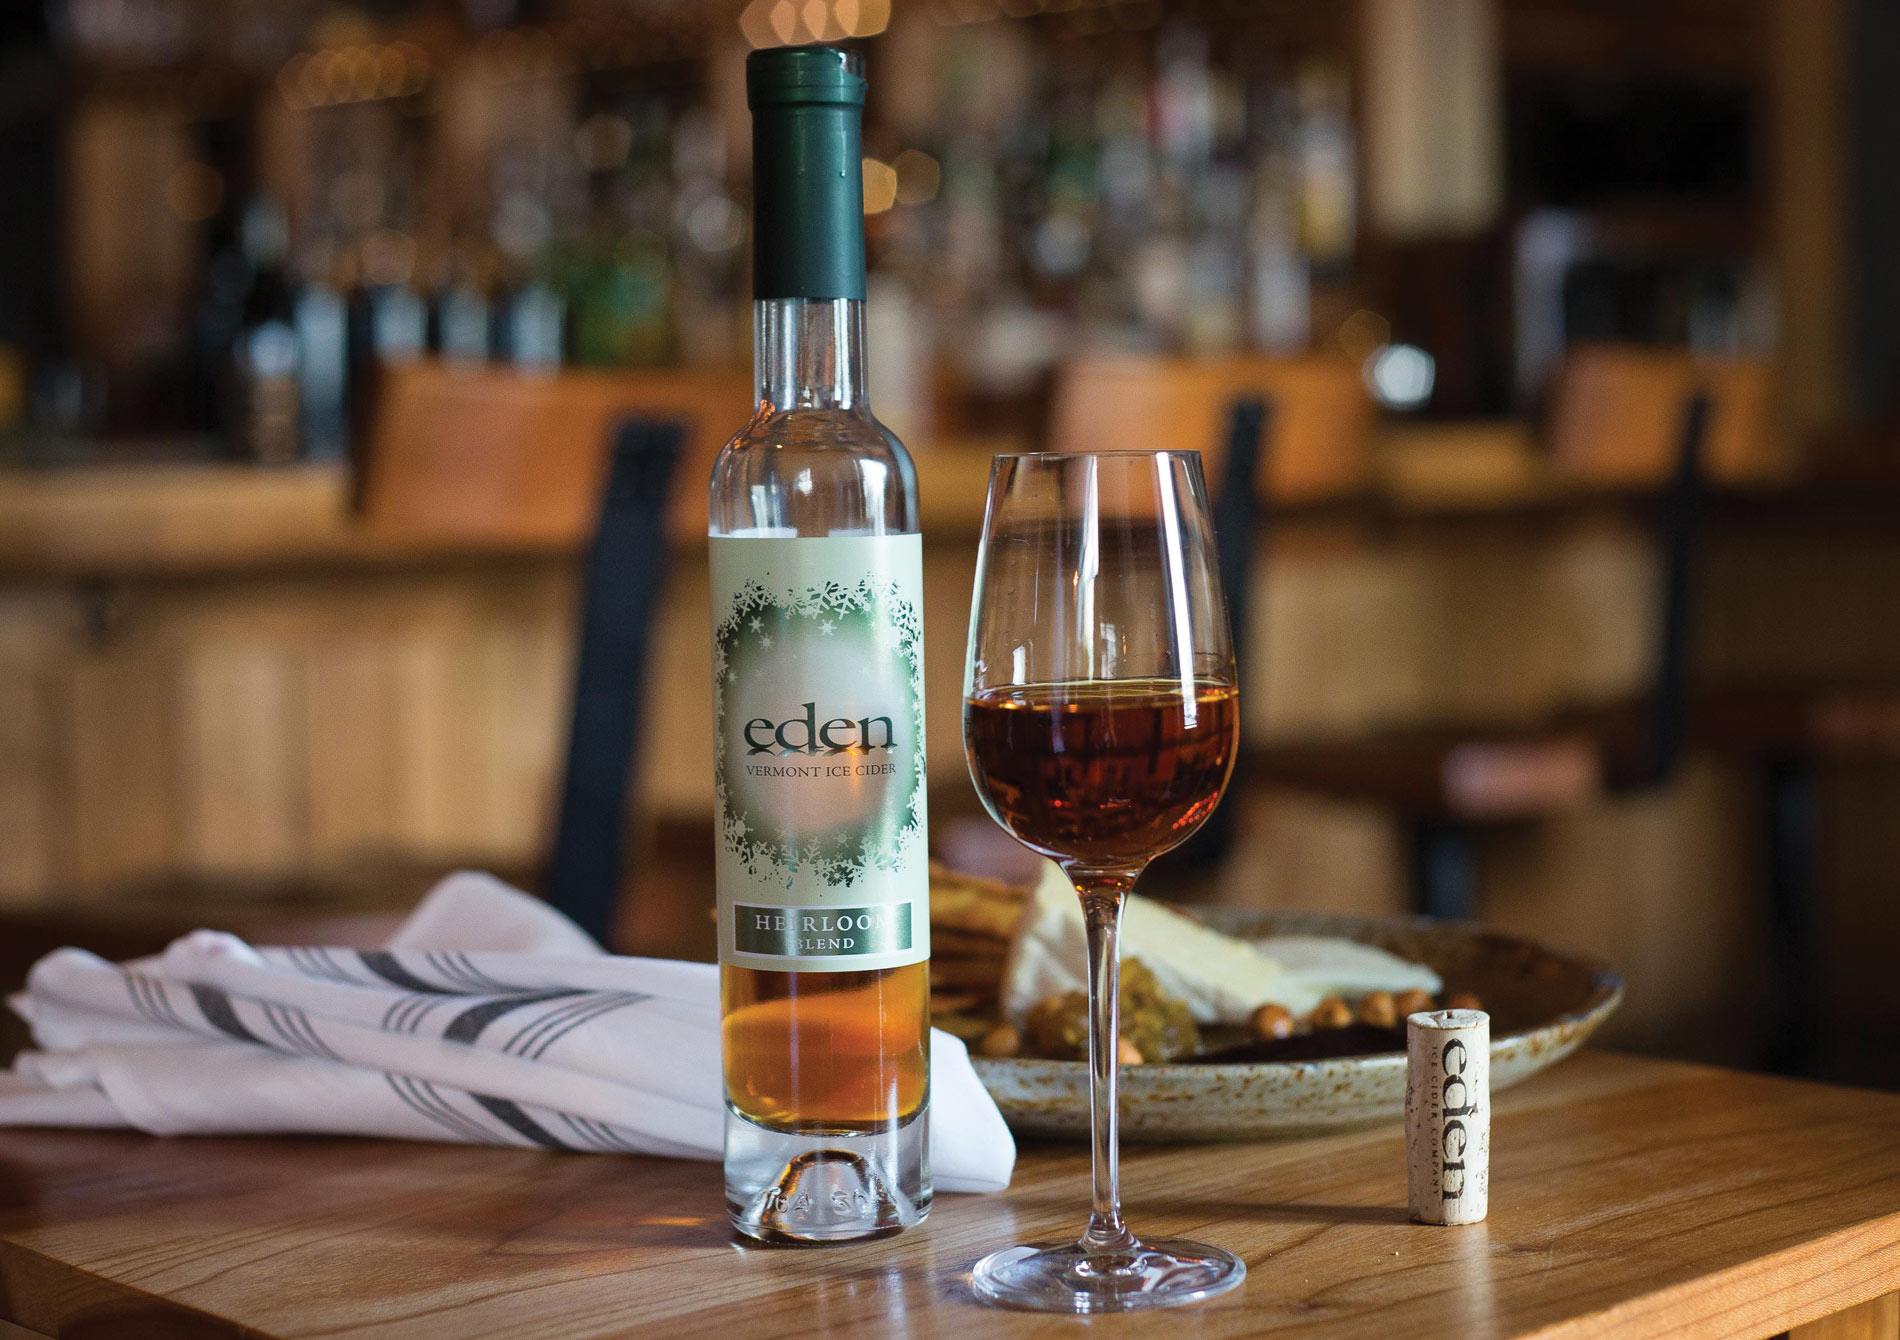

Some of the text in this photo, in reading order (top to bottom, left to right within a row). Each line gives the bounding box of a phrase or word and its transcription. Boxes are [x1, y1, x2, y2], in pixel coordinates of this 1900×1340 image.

[743, 701, 899, 752] eden
[746, 763, 897, 778] VERMONT ICE CIDER
[1441, 1038, 1478, 1200] eden
[1431, 1127, 1439, 1195] COMPANY
